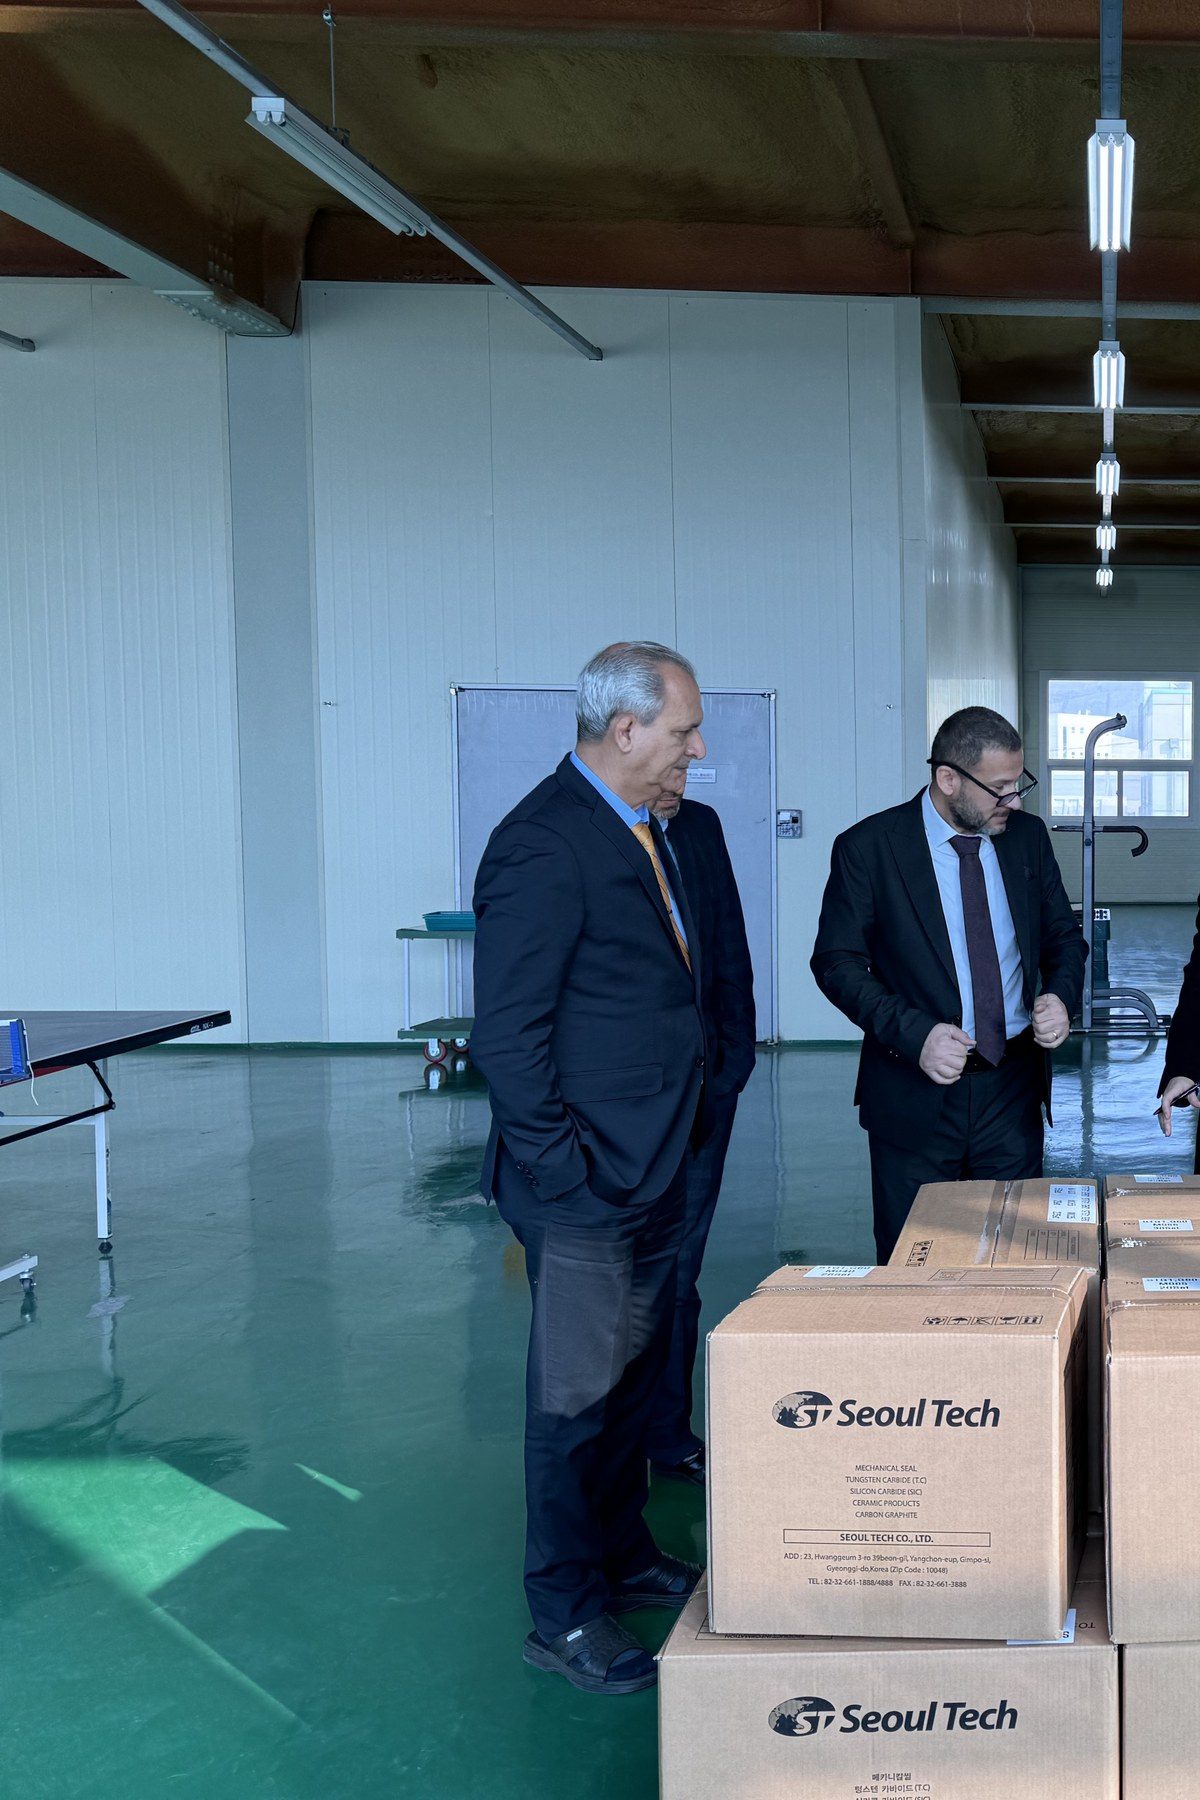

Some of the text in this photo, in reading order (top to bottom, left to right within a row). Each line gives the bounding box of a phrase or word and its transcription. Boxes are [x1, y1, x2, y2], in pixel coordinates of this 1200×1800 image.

[836, 1398, 927, 1428] Seoul
[931, 1399, 1000, 1428] Tech
[855, 1464, 900, 1472] MECHANICAL
[845, 1476, 881, 1484] TUNGSTEN
[882, 1476, 911, 1484] CARBIDE
[839, 1533, 934, 1543] SEOUL TECH CO., LTD.
[814, 1554, 857, 1563] Hwanggeum
[909, 1555, 959, 1565] Yangchon-eup,
[808, 1577, 820, 1585] TEL
[839, 1701, 938, 1734] Seoul
[941, 1699, 1018, 1730] Tech
